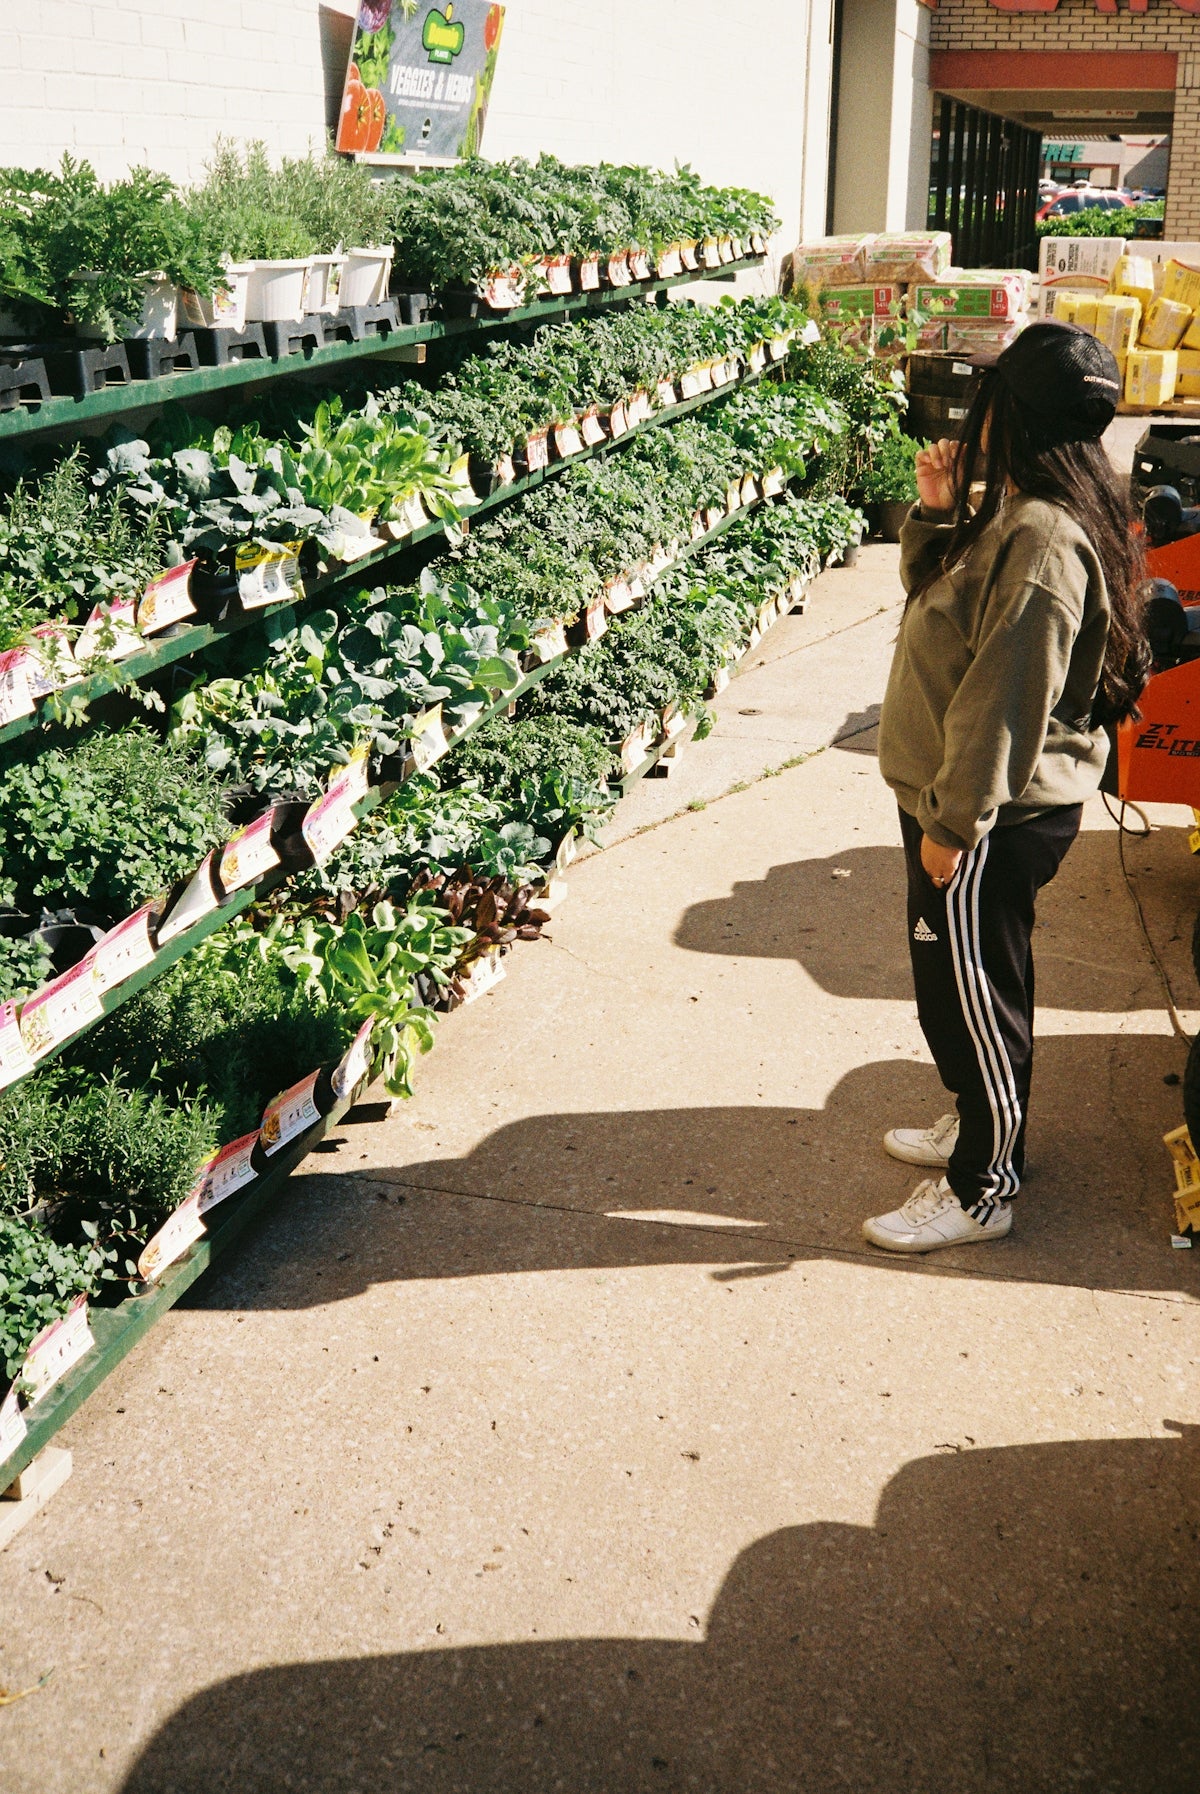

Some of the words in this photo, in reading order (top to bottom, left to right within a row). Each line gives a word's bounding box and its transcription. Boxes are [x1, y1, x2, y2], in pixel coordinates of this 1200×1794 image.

[390, 64, 435, 99] VEGGIES
[434, 72, 445, 101] &
[444, 73, 473, 104] HERBS
[1146, 723, 1180, 735] ZT
[913, 933, 938, 942] adidas
